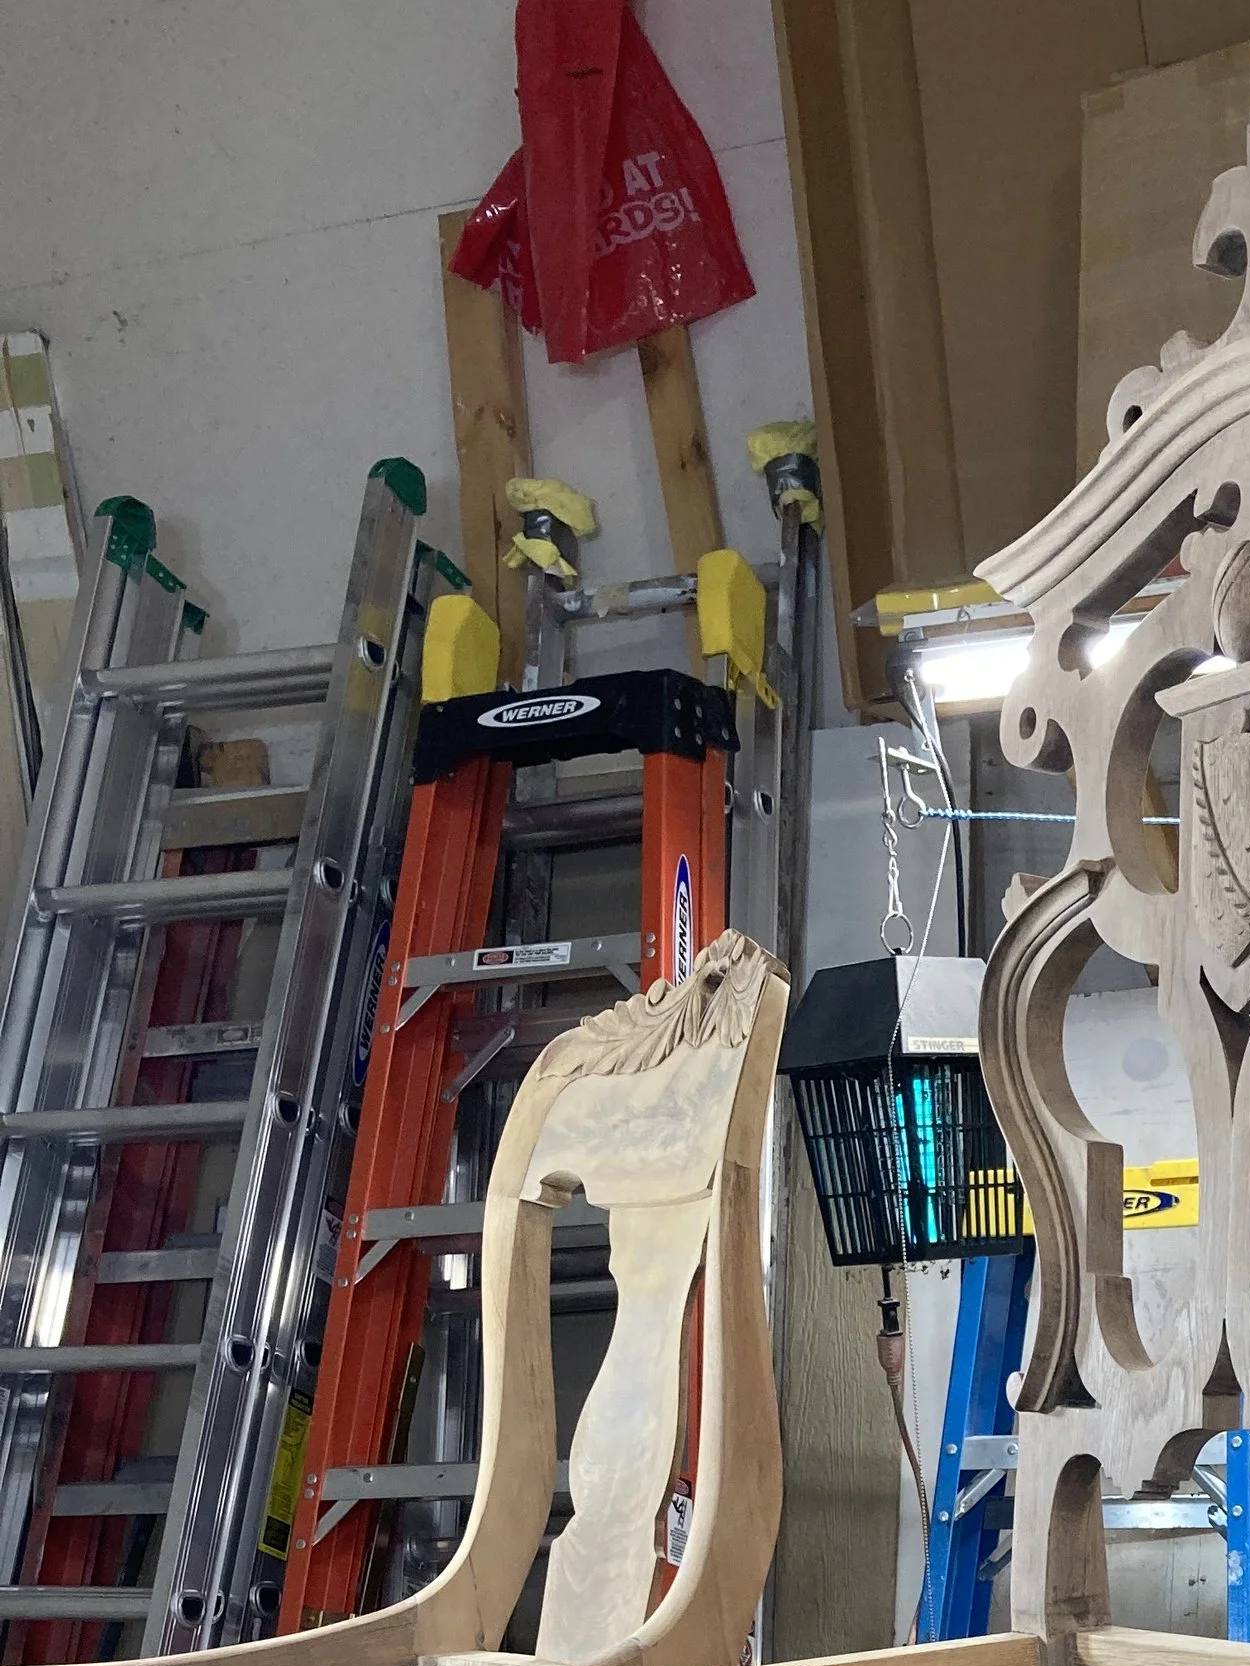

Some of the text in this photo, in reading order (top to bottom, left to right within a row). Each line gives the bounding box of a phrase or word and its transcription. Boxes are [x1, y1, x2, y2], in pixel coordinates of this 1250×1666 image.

[622, 151, 664, 196] AT
[501, 700, 578, 722] WERNER
[359, 950, 386, 1051] WERNER
[912, 1039, 965, 1052] STINGER
